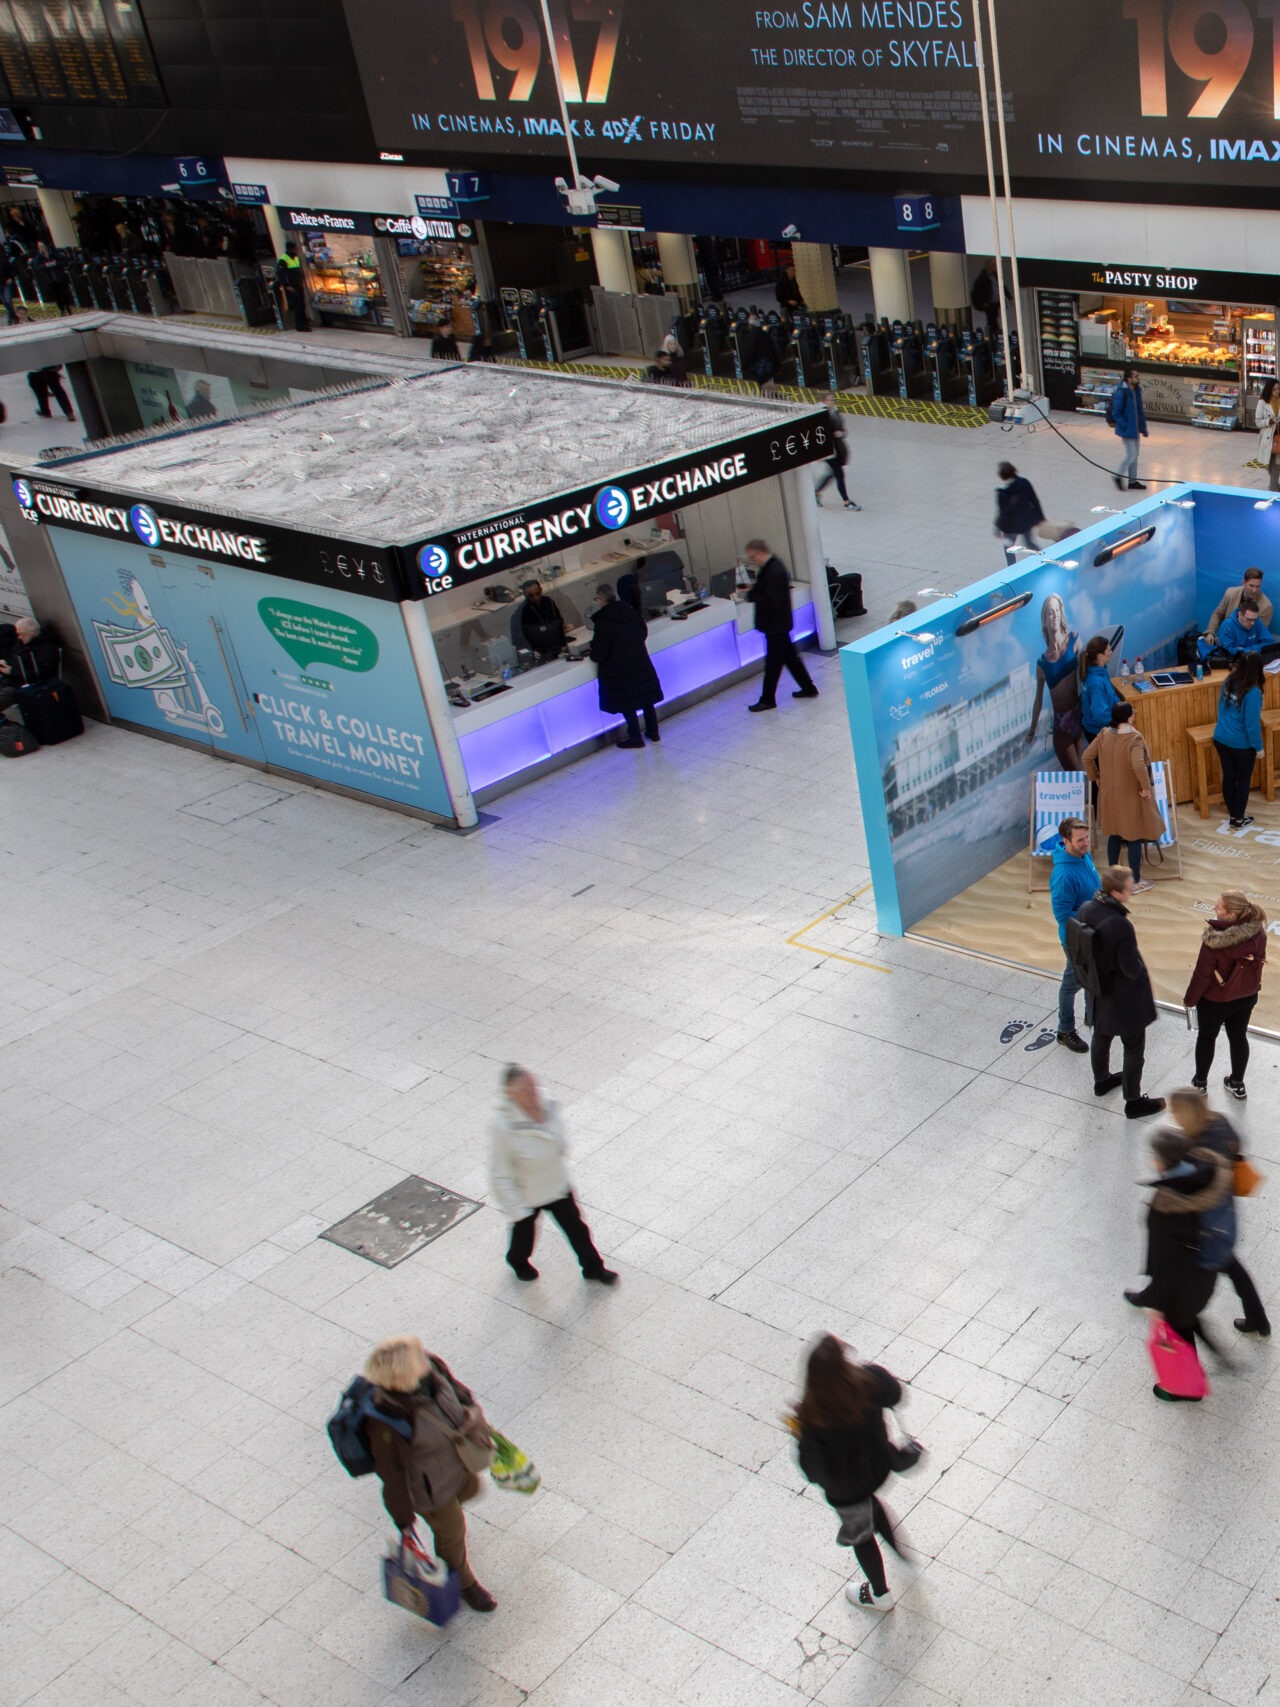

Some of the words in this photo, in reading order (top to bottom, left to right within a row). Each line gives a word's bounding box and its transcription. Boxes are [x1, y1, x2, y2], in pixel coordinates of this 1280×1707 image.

[755, 11, 799, 29] FROM
[803, 1, 852, 29] SAM
[862, 0, 963, 29] MENDES
[452, 0, 625, 103] 1917
[751, 48, 779, 66] THE
[783, 48, 857, 67] DIRECTOR
[861, 49, 884, 67] OF
[889, 40, 985, 68] SKYFALL
[411, 113, 432, 130] IN
[438, 114, 522, 138] CINEMAS,
[523, 117, 579, 136] IMAX
[584, 119, 596, 138] &
[602, 115, 643, 144] 4DX
[649, 121, 717, 142] FRIDAY
[1038, 133, 1064, 154] IN
[1077, 134, 1204, 164] CINEMAS,
[178, 163, 188, 177] 6
[196, 161, 207, 176] 6
[451, 178, 460, 193] 7
[470, 177, 480, 193] 7
[290, 211, 317, 226] Delice
[324, 216, 355, 230] France
[902, 203, 913, 221] 8
[924, 202, 934, 220] 8
[1091, 271, 1105, 284] The
[1104, 270, 1152, 288] PASTY
[1156, 273, 1198, 291] SHOP
[1142, 379, 1183, 401] ANDMADE
[1156, 390, 1164, 399] in
[1143, 401, 1186, 414] ORNWALL
[32, 483, 78, 499] INTERNATIONAL
[20, 504, 39, 522] ice
[456, 503, 593, 570] CURRENCY
[629, 453, 748, 512] EXCHANGE
[36, 493, 130, 533] CURRENCY
[157, 519, 268, 563] EXCHANGE
[456, 515, 526, 544] INTERNATIONAL
[423, 574, 454, 595] ice
[901, 643, 935, 670] travel
[933, 632, 944, 647] up
[258, 693, 317, 727] CLICK
[318, 708, 334, 730] &
[336, 714, 425, 756] COLLECT
[272, 720, 347, 758] TRAVEL
[349, 741, 421, 780] MONEY
[1039, 791, 1071, 801] travel
[1071, 785, 1082, 797] up
[1191, 838, 1255, 860] Flights
[1192, 900, 1216, 912] VISI
